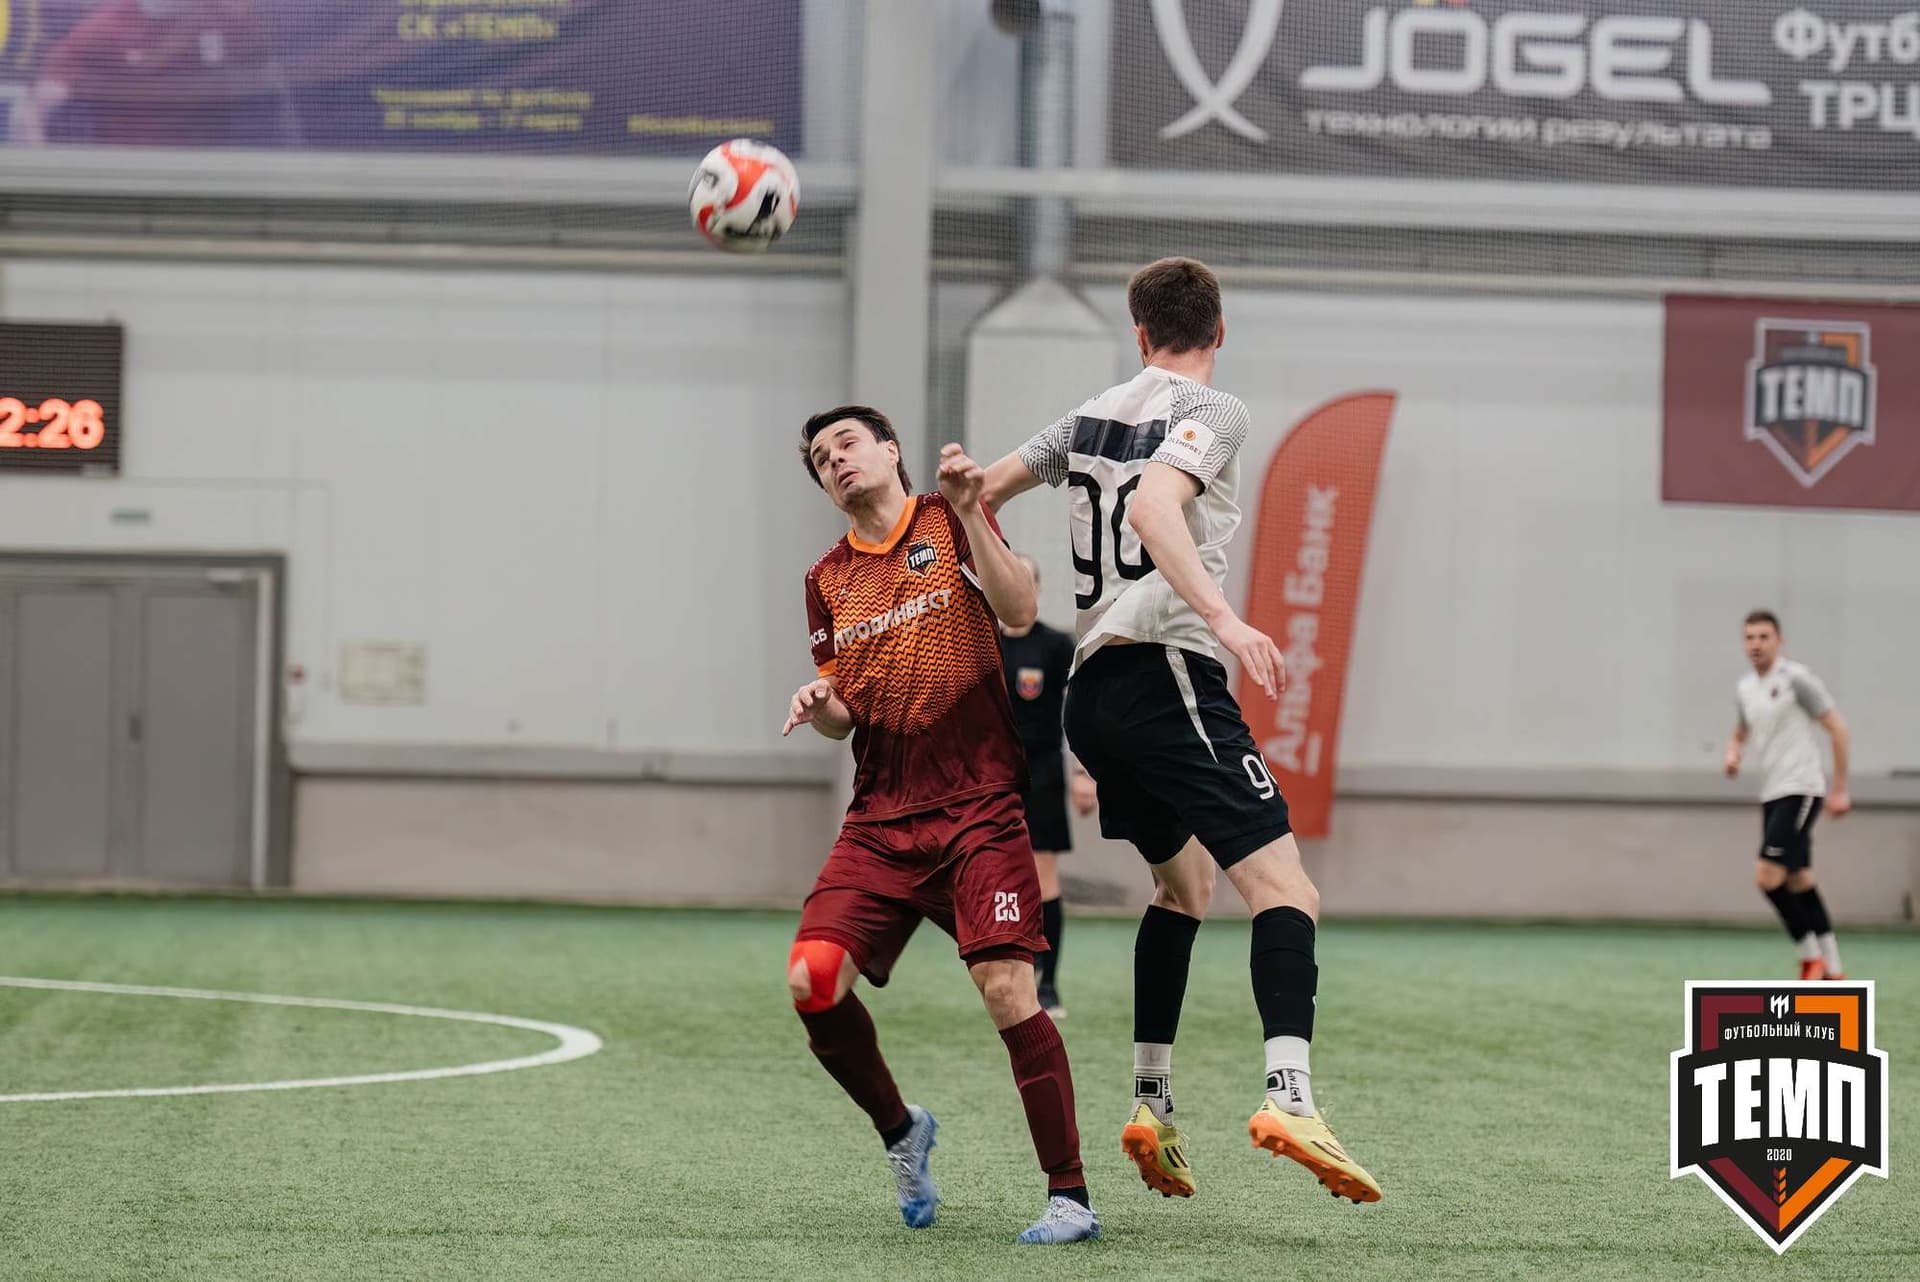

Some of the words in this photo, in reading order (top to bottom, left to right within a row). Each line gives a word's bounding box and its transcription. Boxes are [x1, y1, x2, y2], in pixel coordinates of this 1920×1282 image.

[1541, 118, 1773, 150] результата
[1760, 364, 1864, 428] ТЕМП
[909, 547, 935, 569] ТЕМП
[1282, 486, 1339, 606] Банк
[1264, 612, 1326, 774] Альфа
[1242, 751, 1282, 800] 9
[994, 891, 1021, 922] 23
